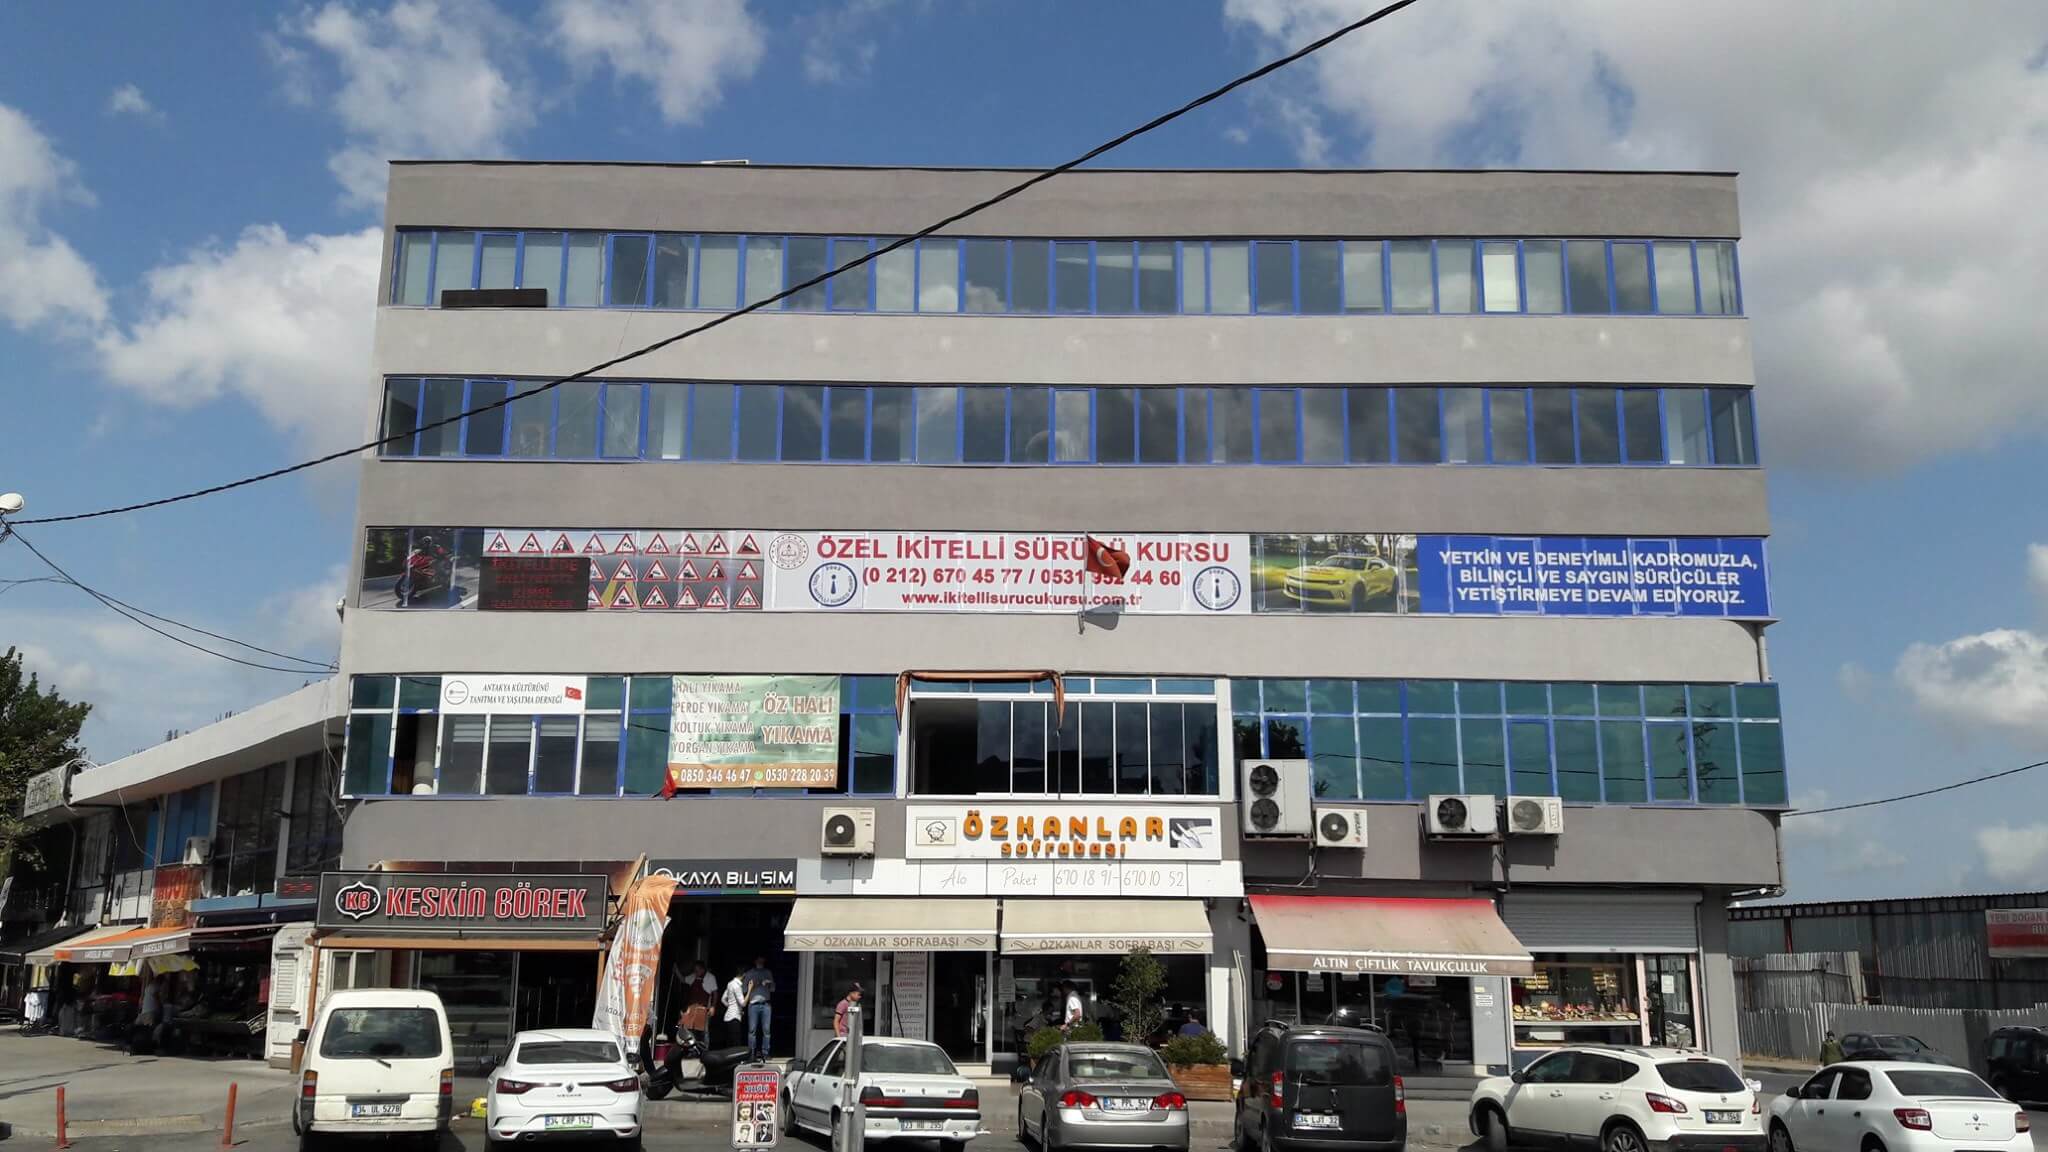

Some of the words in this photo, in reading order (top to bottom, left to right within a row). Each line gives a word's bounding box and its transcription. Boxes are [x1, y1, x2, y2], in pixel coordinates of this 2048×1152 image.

[817, 535, 888, 559] ÖZEL
[897, 535, 1004, 560] İKİTELLİ
[1014, 537, 1126, 561] SÜRÜÜ
[1137, 541, 1229, 562] KURSU
[1439, 549, 1501, 565] YETKİN
[1506, 551, 1530, 565] VE
[1535, 550, 1627, 566] DENEYİMLİ
[1632, 553, 1758, 570] KADROMUZLA,
[862, 567, 880, 587] (0
[886, 567, 926, 587] 212)
[933, 568, 966, 584] 670
[972, 568, 995, 584] 45
[1001, 569, 1023, 584] 77
[1041, 569, 1083, 585] 0531
[1130, 570, 1154, 586] 44
[1159, 571, 1180, 586] 60
[1460, 567, 1532, 585] BİLİNÇLİ
[1537, 570, 1560, 583] VE
[1565, 571, 1629, 584] SAYGIN
[1634, 568, 1740, 585] SÜRÜCÜLER
[1457, 585, 1582, 604] YETİŞTİRMEYE
[1588, 588, 1648, 603] DEVAM
[1653, 586, 1745, 604] EDİYORUZ.
[702, 682, 741, 693] YIKAMA
[675, 701, 705, 713] PERDE
[707, 701, 748, 713] YIKAMA
[764, 691, 787, 714] ÖZ
[793, 696, 833, 714] HALI
[674, 721, 711, 734] KOLTUK
[714, 721, 754, 734] YIKAMA
[762, 725, 833, 745] YIKAMA
[672, 741, 712, 754] YORGAN
[714, 741, 755, 754] YIKAMA
[680, 768, 701, 783] 0850
[705, 769, 723, 783] 346
[725, 769, 737, 783] 46
[739, 768, 751, 783] 47
[765, 769, 788, 783] 0530
[790, 769, 807, 783] 228
[810, 769, 822, 783] 20
[963, 810, 1164, 841] ÖZKANLAR
[676, 871, 722, 885] KAYA
[1002, 866, 1038, 889] Paket
[1169, 870, 1185, 888] 52
[344, 891, 371, 911] KB
[494, 881, 587, 918] BÖREK
[1313, 956, 1348, 970] ALTIN
[1356, 957, 1400, 972] ÇİFTLİK
[1406, 959, 1488, 975] TAVUKÇULUK
